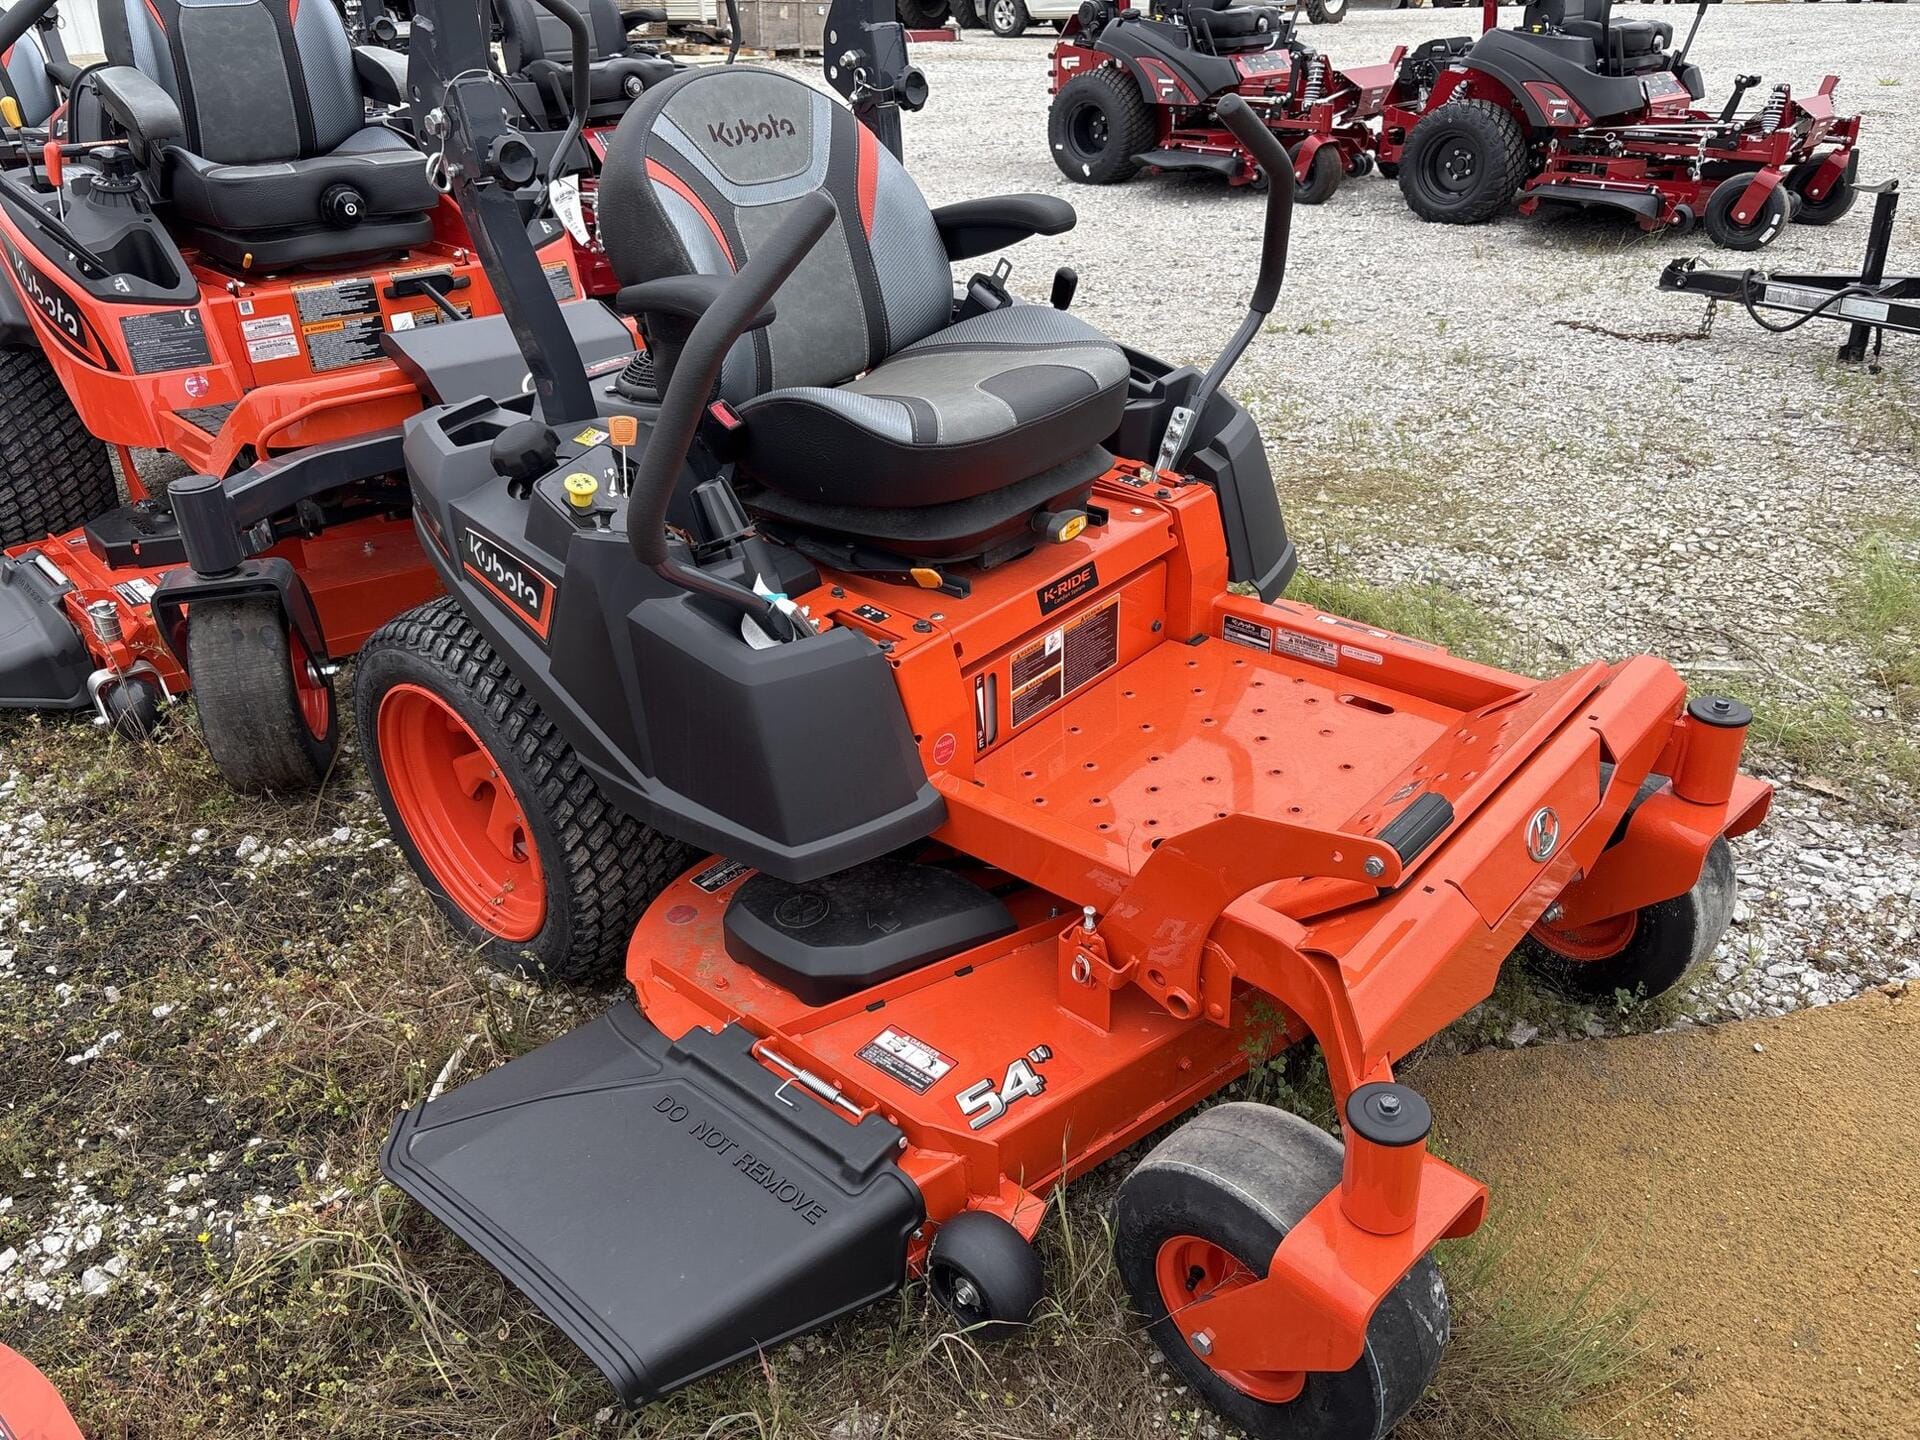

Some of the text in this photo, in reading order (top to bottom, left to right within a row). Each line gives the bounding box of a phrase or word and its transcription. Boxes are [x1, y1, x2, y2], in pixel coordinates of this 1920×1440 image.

[707, 113, 796, 148] Kubota
[13, 250, 78, 337] Kubota
[470, 534, 537, 609] Kubota
[1044, 567, 1092, 603] K-RIDE
[652, 1094, 828, 1226] DO NOT REMOVE
